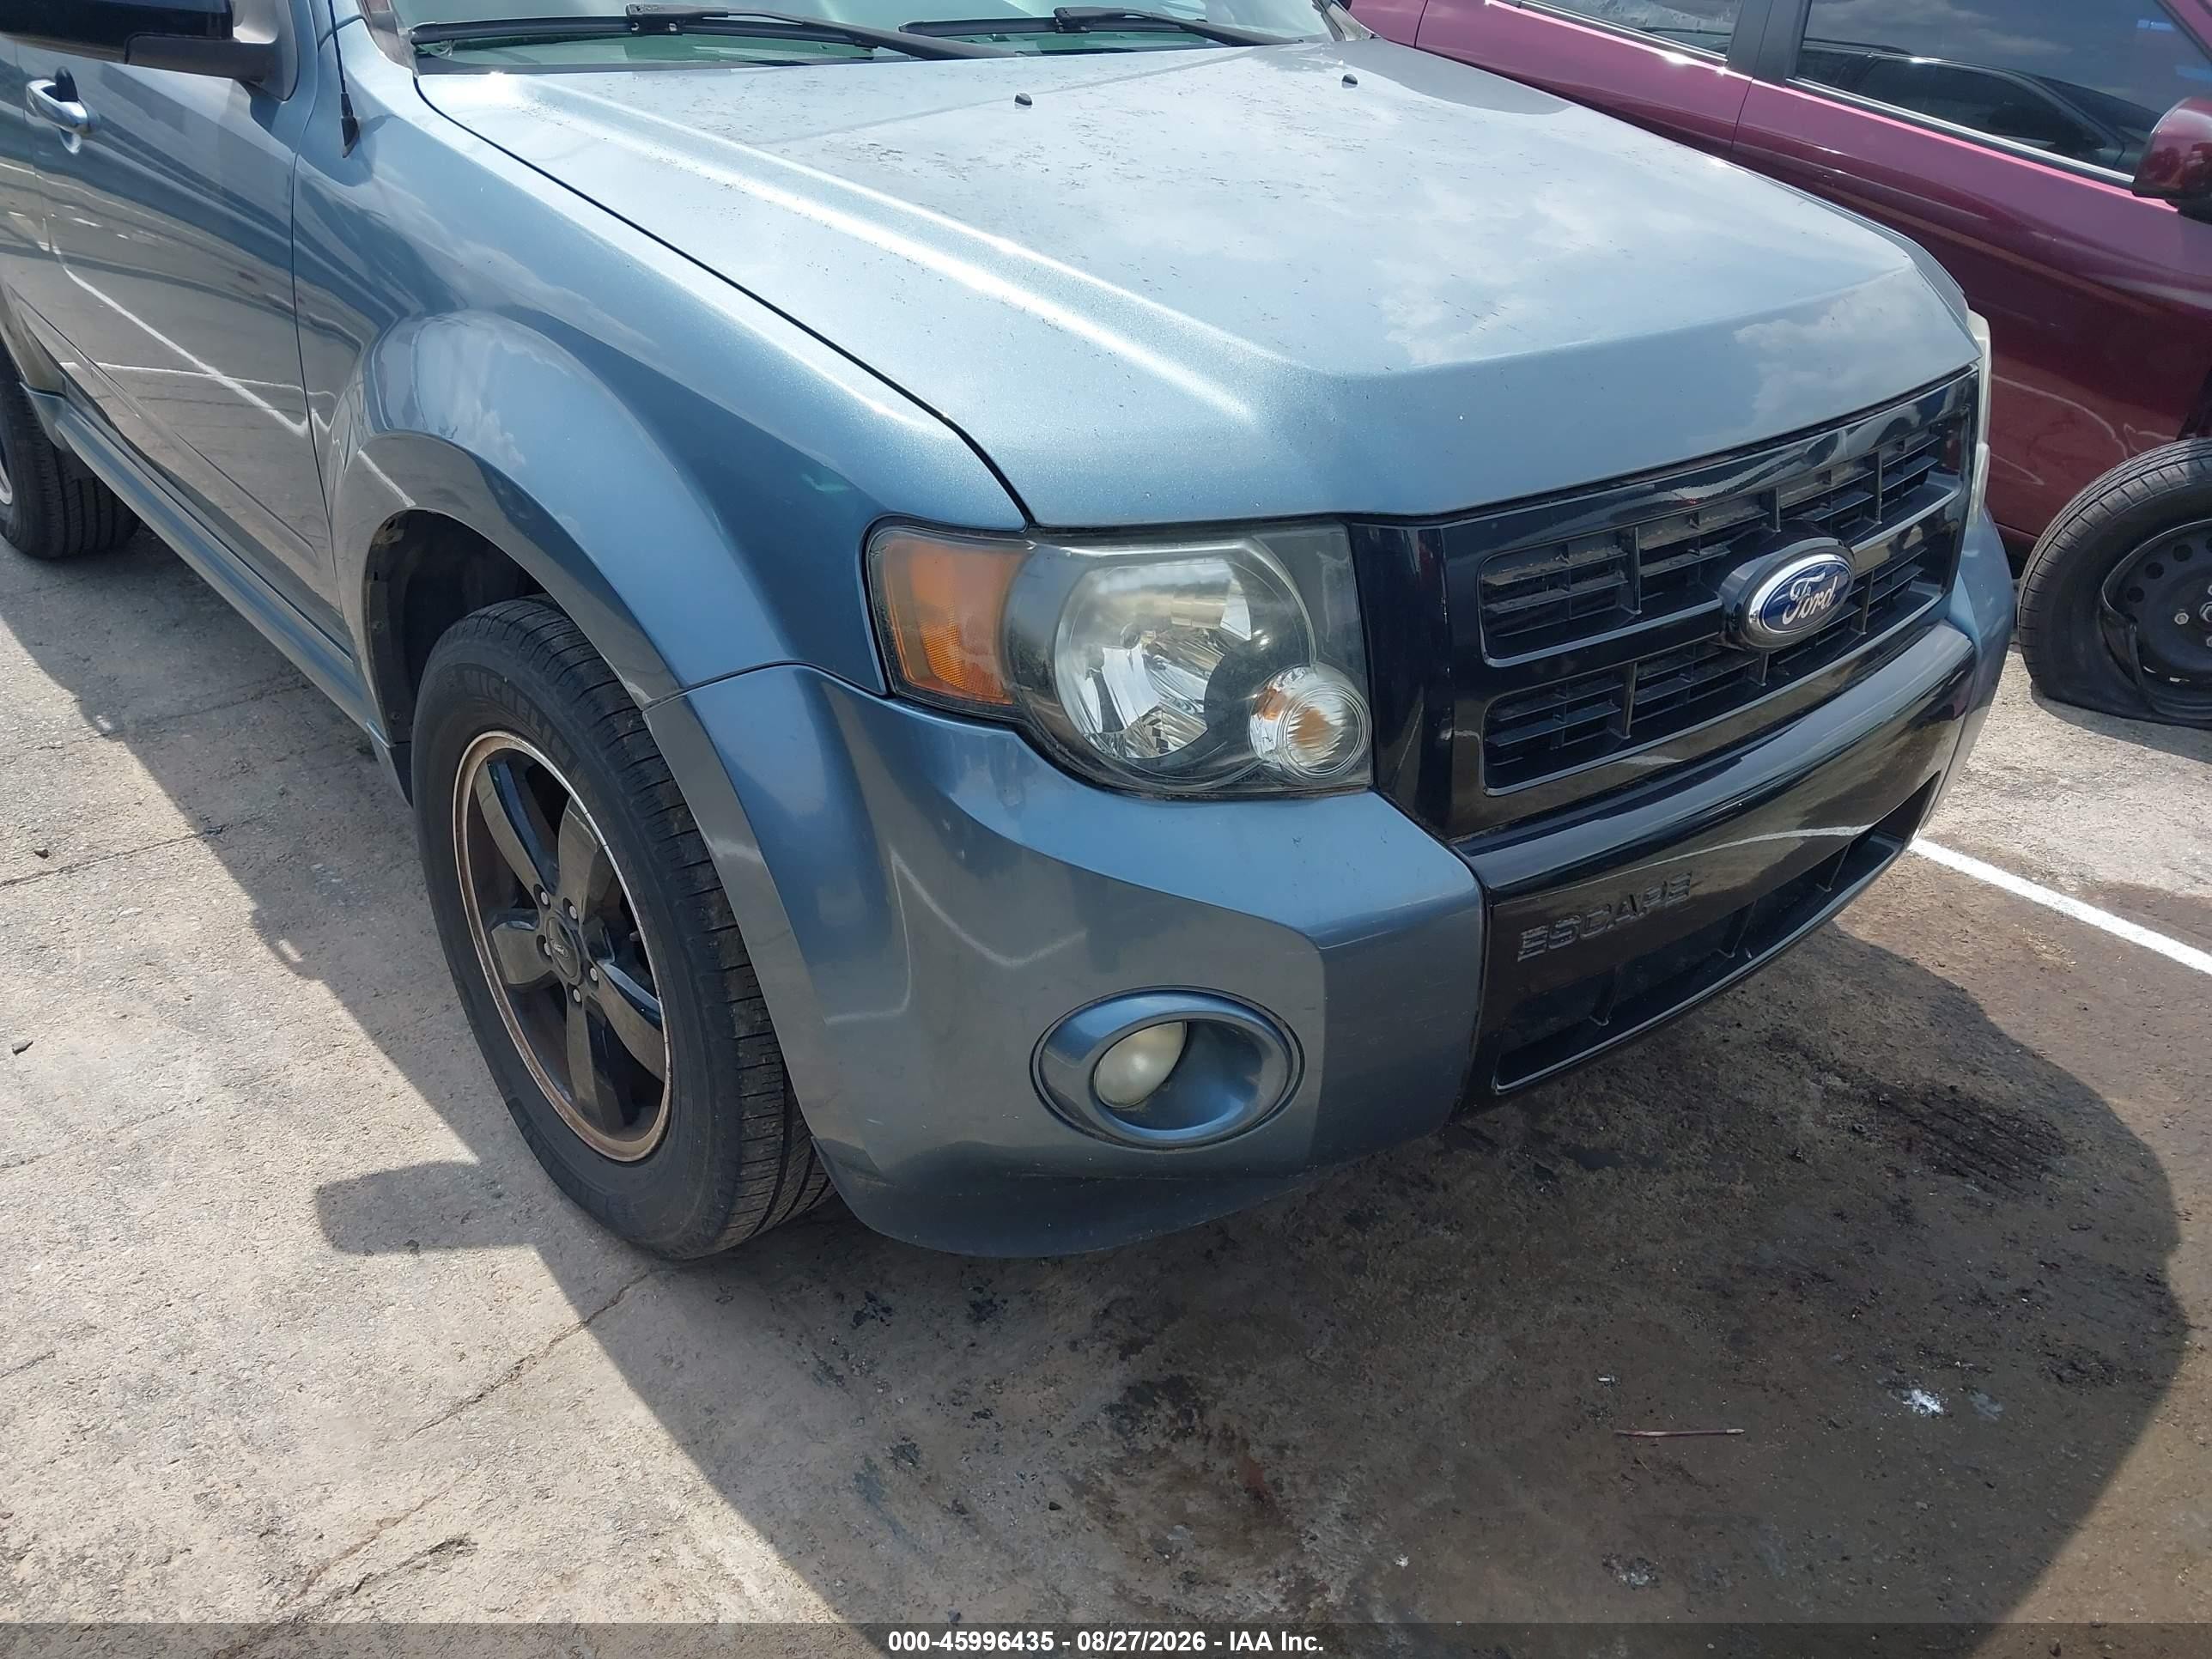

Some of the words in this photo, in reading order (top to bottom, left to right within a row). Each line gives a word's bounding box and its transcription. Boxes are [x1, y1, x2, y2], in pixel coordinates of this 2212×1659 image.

[1782, 572, 1838, 626] Ford
[462, 669, 572, 768] MICHELIN
[1517, 871, 1693, 963] ESCAPE
